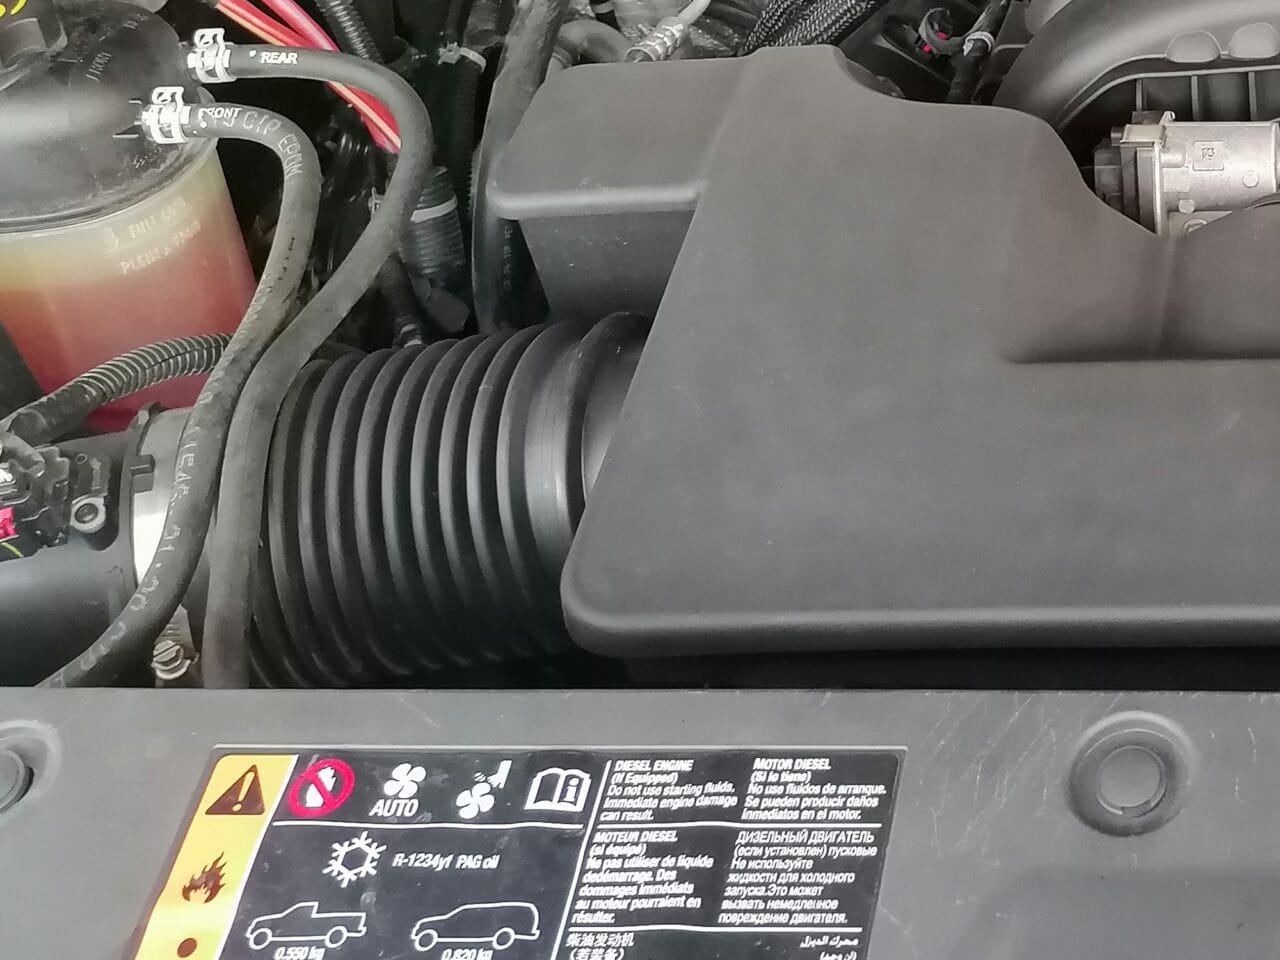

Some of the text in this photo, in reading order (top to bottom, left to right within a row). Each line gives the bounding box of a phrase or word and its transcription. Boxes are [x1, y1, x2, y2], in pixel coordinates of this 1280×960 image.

[260, 51, 298, 65] REAR
[197, 107, 243, 123] FRONT
[613, 759, 694, 771] DIESEL ENGINE
[753, 757, 832, 770] MOTOR DIESEL
[779, 771, 812, 783] tiene)
[607, 784, 623, 796] Do
[623, 784, 642, 796] not
[642, 785, 663, 796] use
[662, 783, 703, 797] starting
[747, 783, 887, 796] No use fluidos de arranque.
[369, 798, 419, 817] AUTO
[659, 797, 695, 810] engine
[695, 795, 738, 808] damage
[744, 795, 879, 809] Se pueden producir daños
[599, 810, 621, 820] can
[800, 809, 816, 820] en
[816, 808, 828, 820] el
[592, 830, 679, 843] MOTEUR DIESEL
[735, 829, 875, 845] ДИЗЕЛЬНЫЙ ДВИГАТЕЛЬ
[734, 845, 878, 859] (если установлен) пусковые
[392, 852, 500, 872] R-1234yf PAG oil
[602, 858, 623, 871] pas
[661, 855, 676, 867] de
[676, 854, 714, 869] liquide
[730, 857, 814, 871] Не используйте
[655, 868, 678, 881] Des
[777, 872, 799, 884] для
[799, 872, 856, 884] холодного
[579, 884, 639, 898] dommages
[788, 885, 824, 896] может
[575, 895, 702, 911] au moteur pourraient en
[721, 899, 765, 910] вызвать
[274, 947, 309, 960] 0.550
